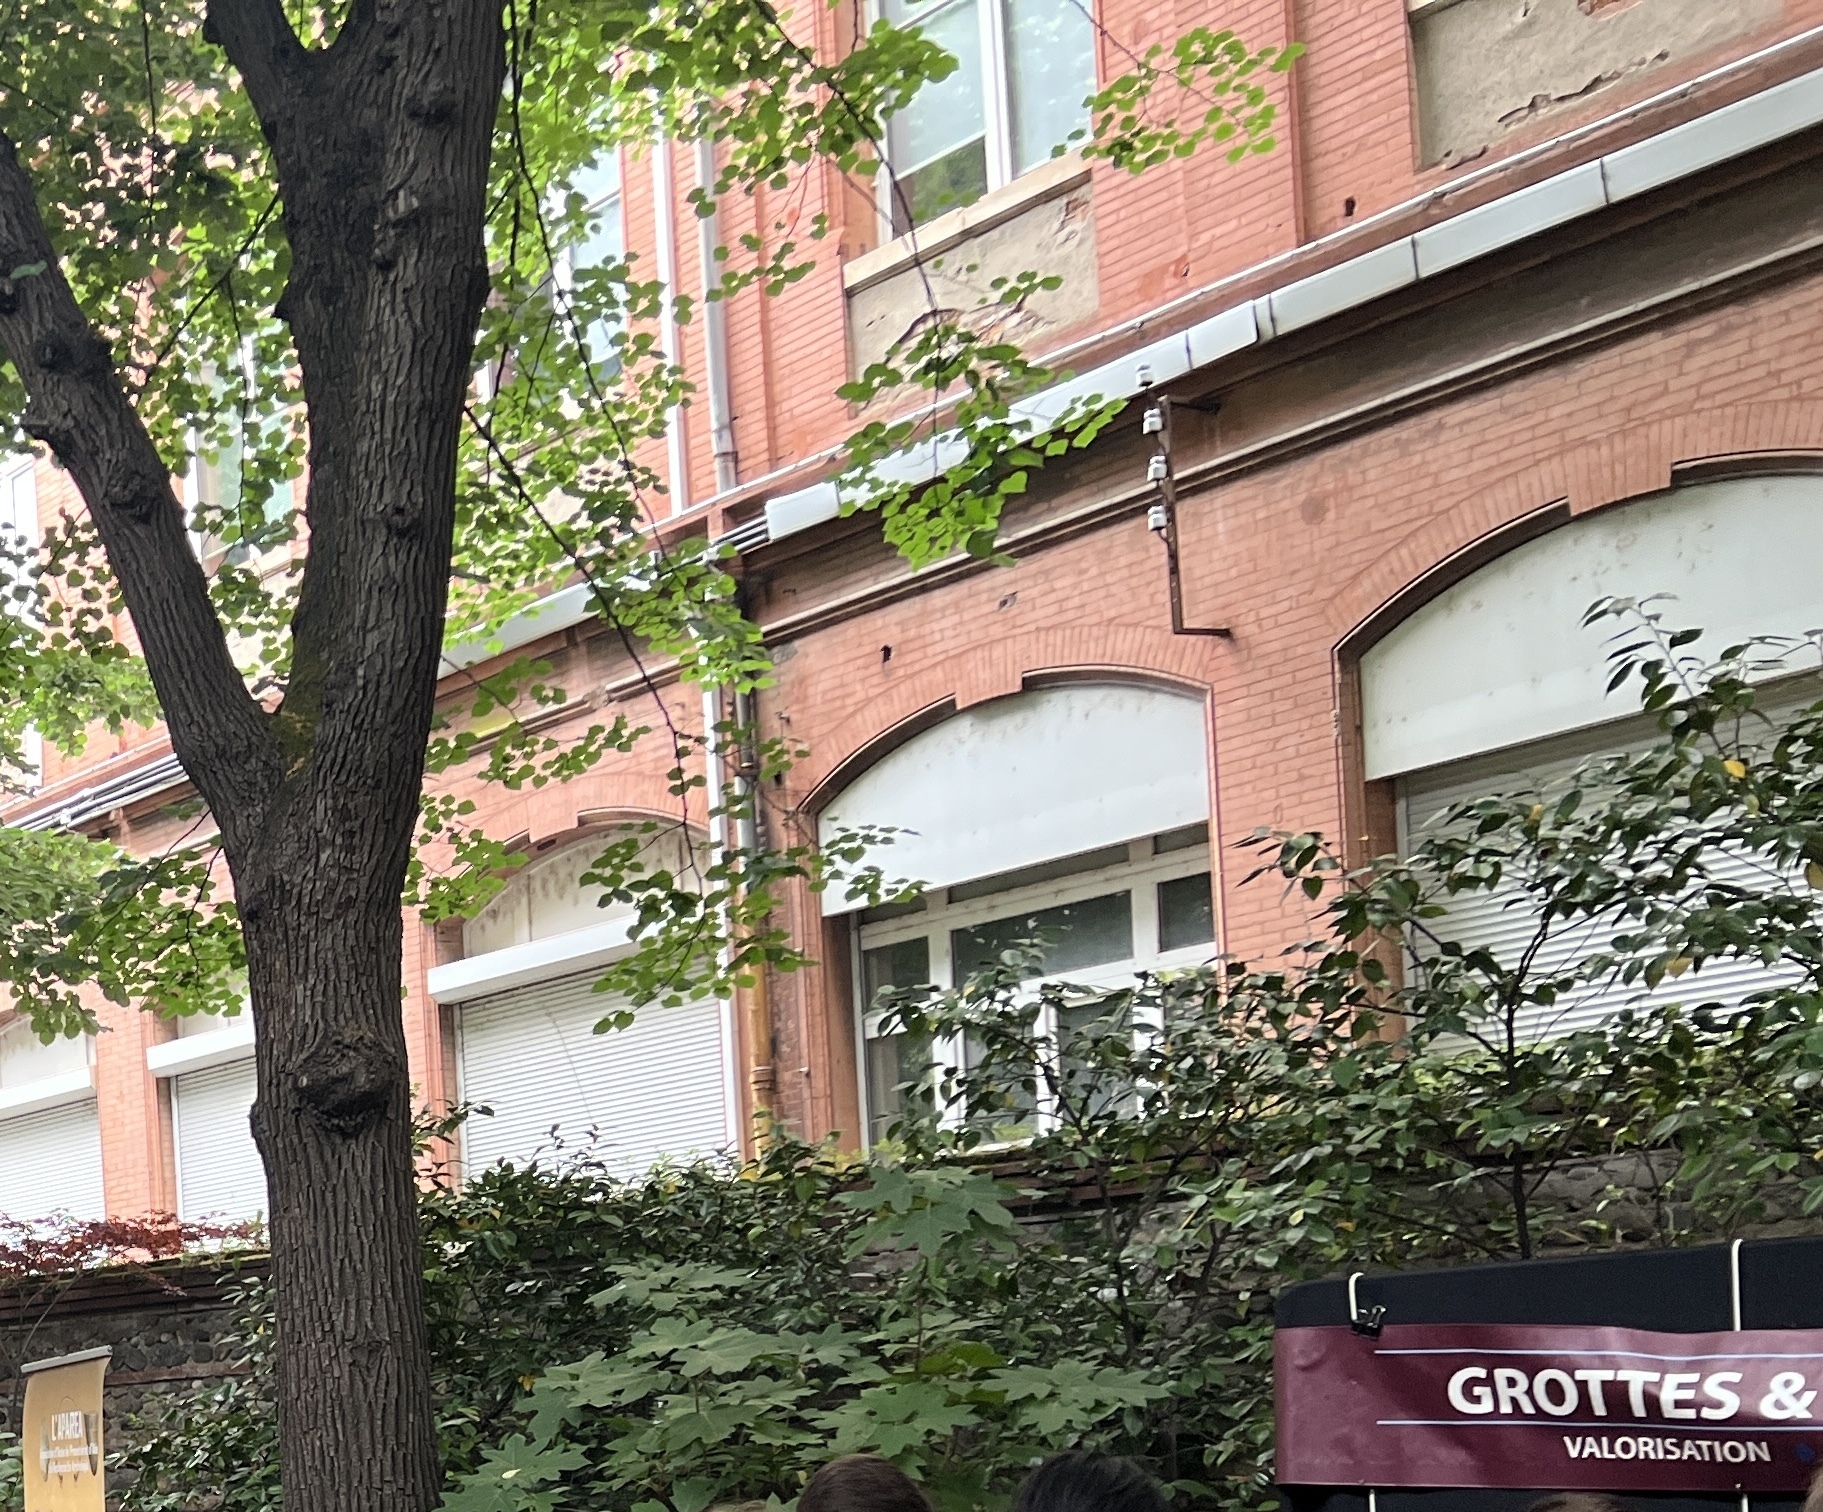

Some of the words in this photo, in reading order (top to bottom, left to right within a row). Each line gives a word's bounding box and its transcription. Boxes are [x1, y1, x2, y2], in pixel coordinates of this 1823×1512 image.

[1447, 1366, 1744, 1421] GROTTES
[1759, 1371, 1818, 1420] &
[1563, 1436, 1771, 1462] VALORISATION
